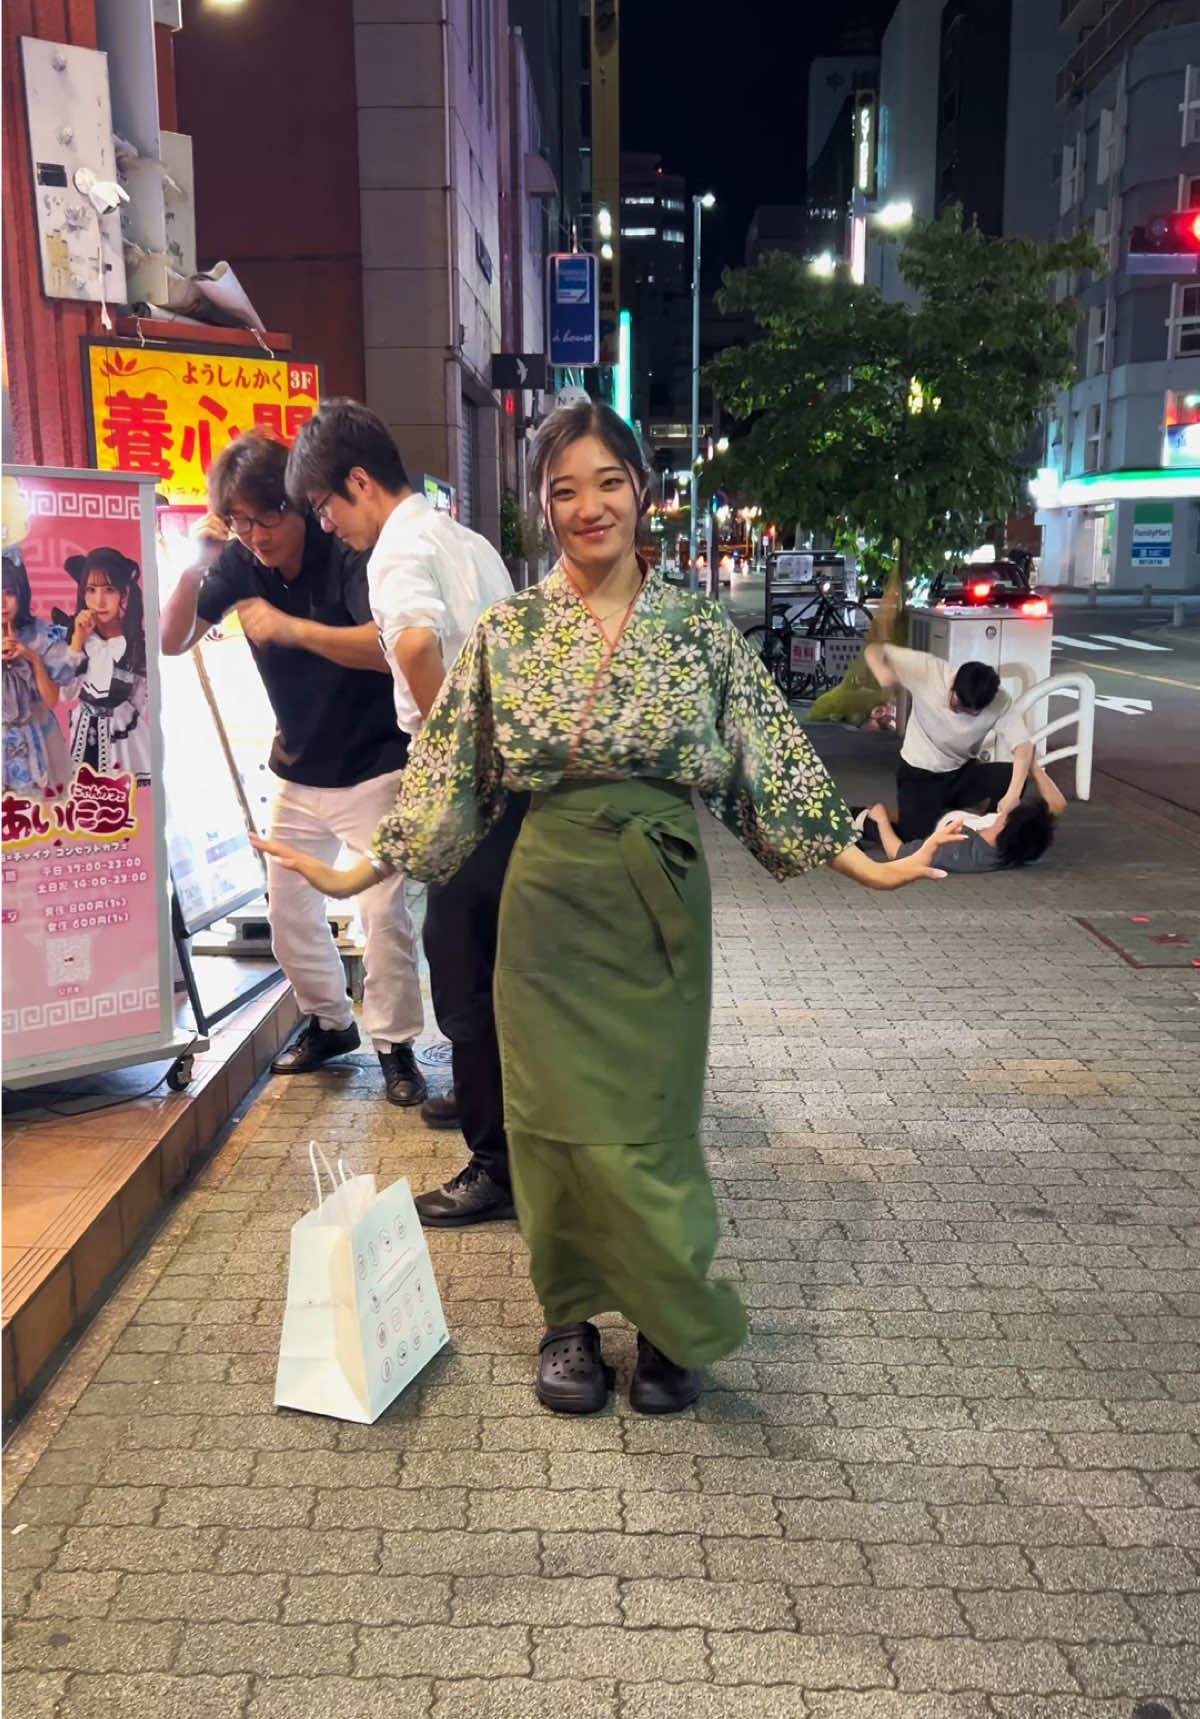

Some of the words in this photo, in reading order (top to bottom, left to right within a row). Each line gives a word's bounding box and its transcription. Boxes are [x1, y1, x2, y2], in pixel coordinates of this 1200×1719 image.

[182, 361, 282, 391] ようしんかく
[290, 370, 313, 390] 3F
[1135, 527, 1170, 538] FamilyMart
[71, 783, 126, 802] にゃんカフェ
[56, 842, 128, 858] コンセプトカフェ
